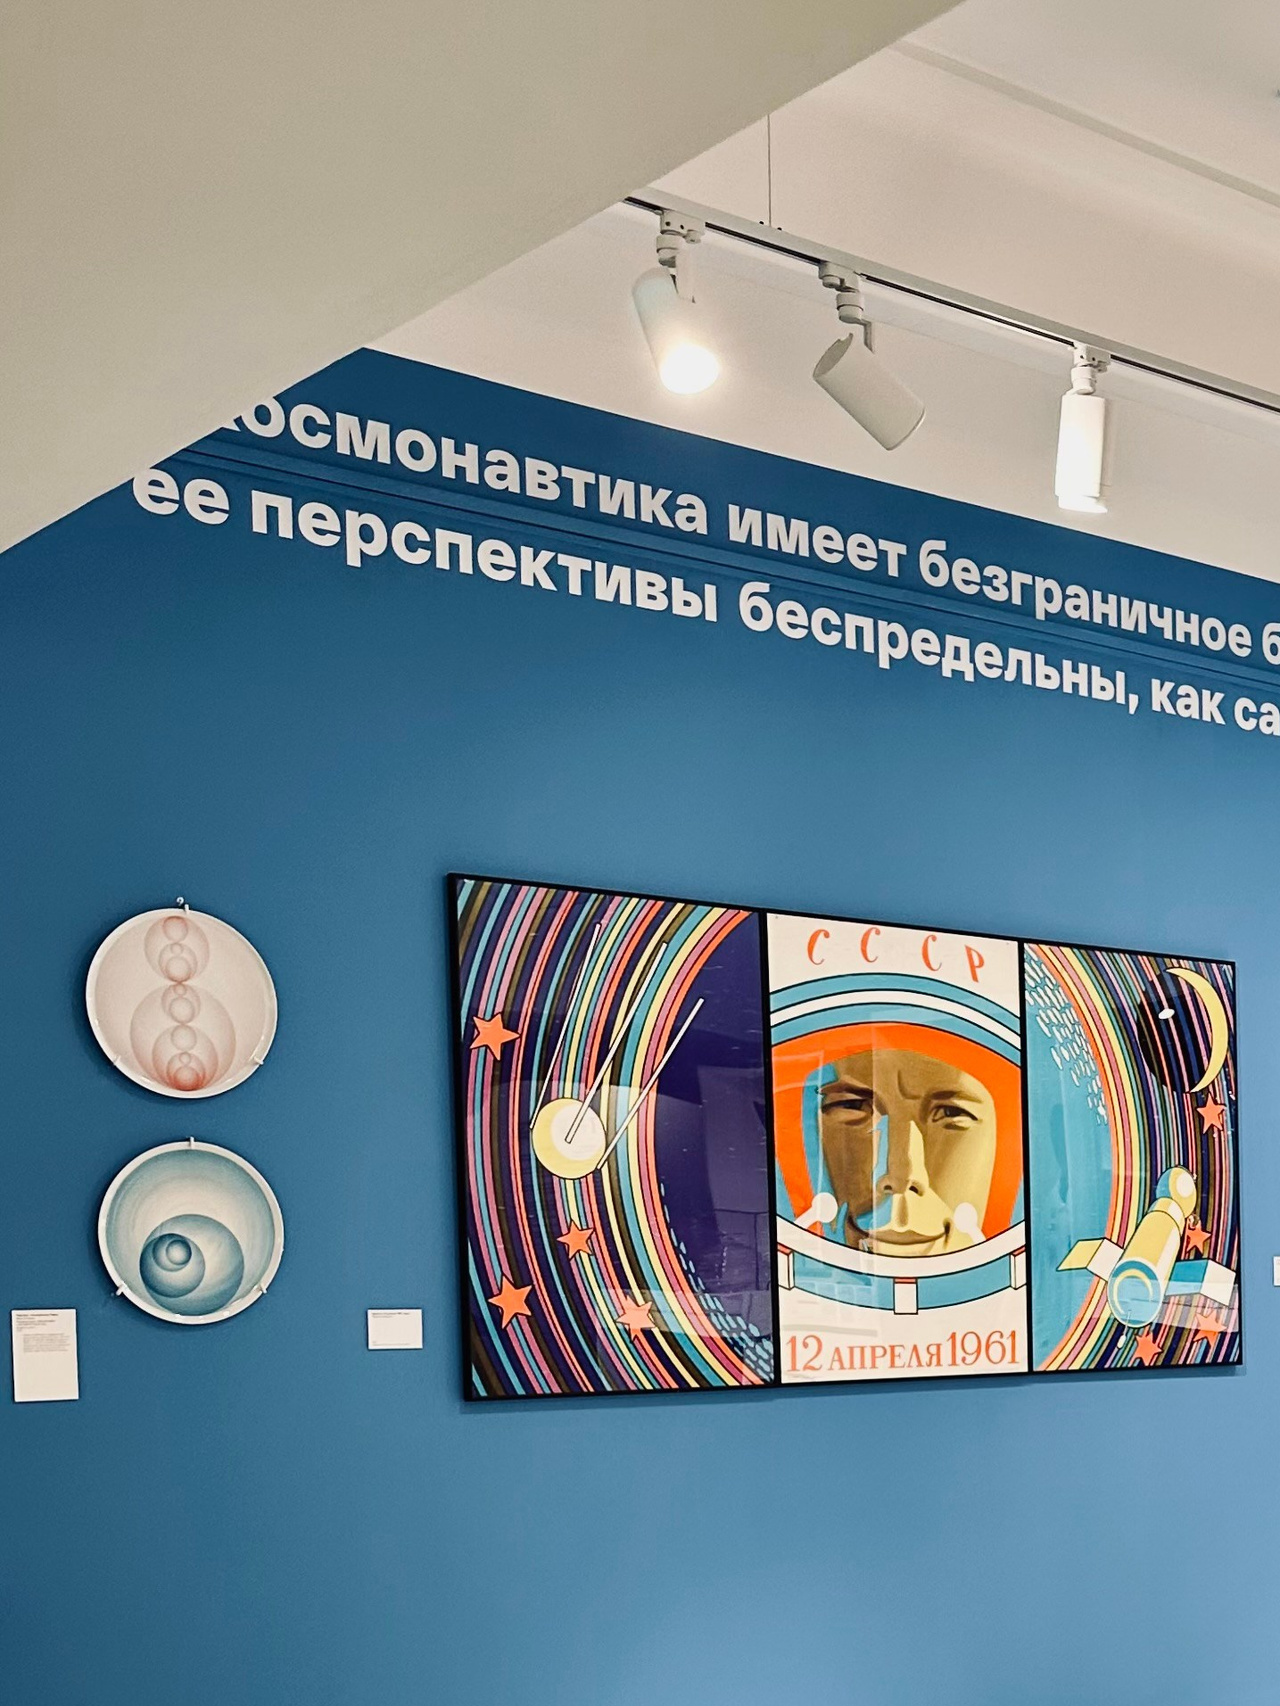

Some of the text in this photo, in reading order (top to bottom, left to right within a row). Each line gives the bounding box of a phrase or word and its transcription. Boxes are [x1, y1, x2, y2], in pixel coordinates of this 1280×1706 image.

[132, 468, 230, 525] ее
[251, 489, 717, 623] перспективы
[739, 581, 1140, 715] беспредельны,
[1151, 678, 1226, 725] как
[222, 397, 707, 534] осмонавтика
[728, 504, 907, 577] имеет
[919, 540, 1252, 657] безграничное
[786, 1329, 1020, 1372] 12 АПРЕЛЯ 1961
